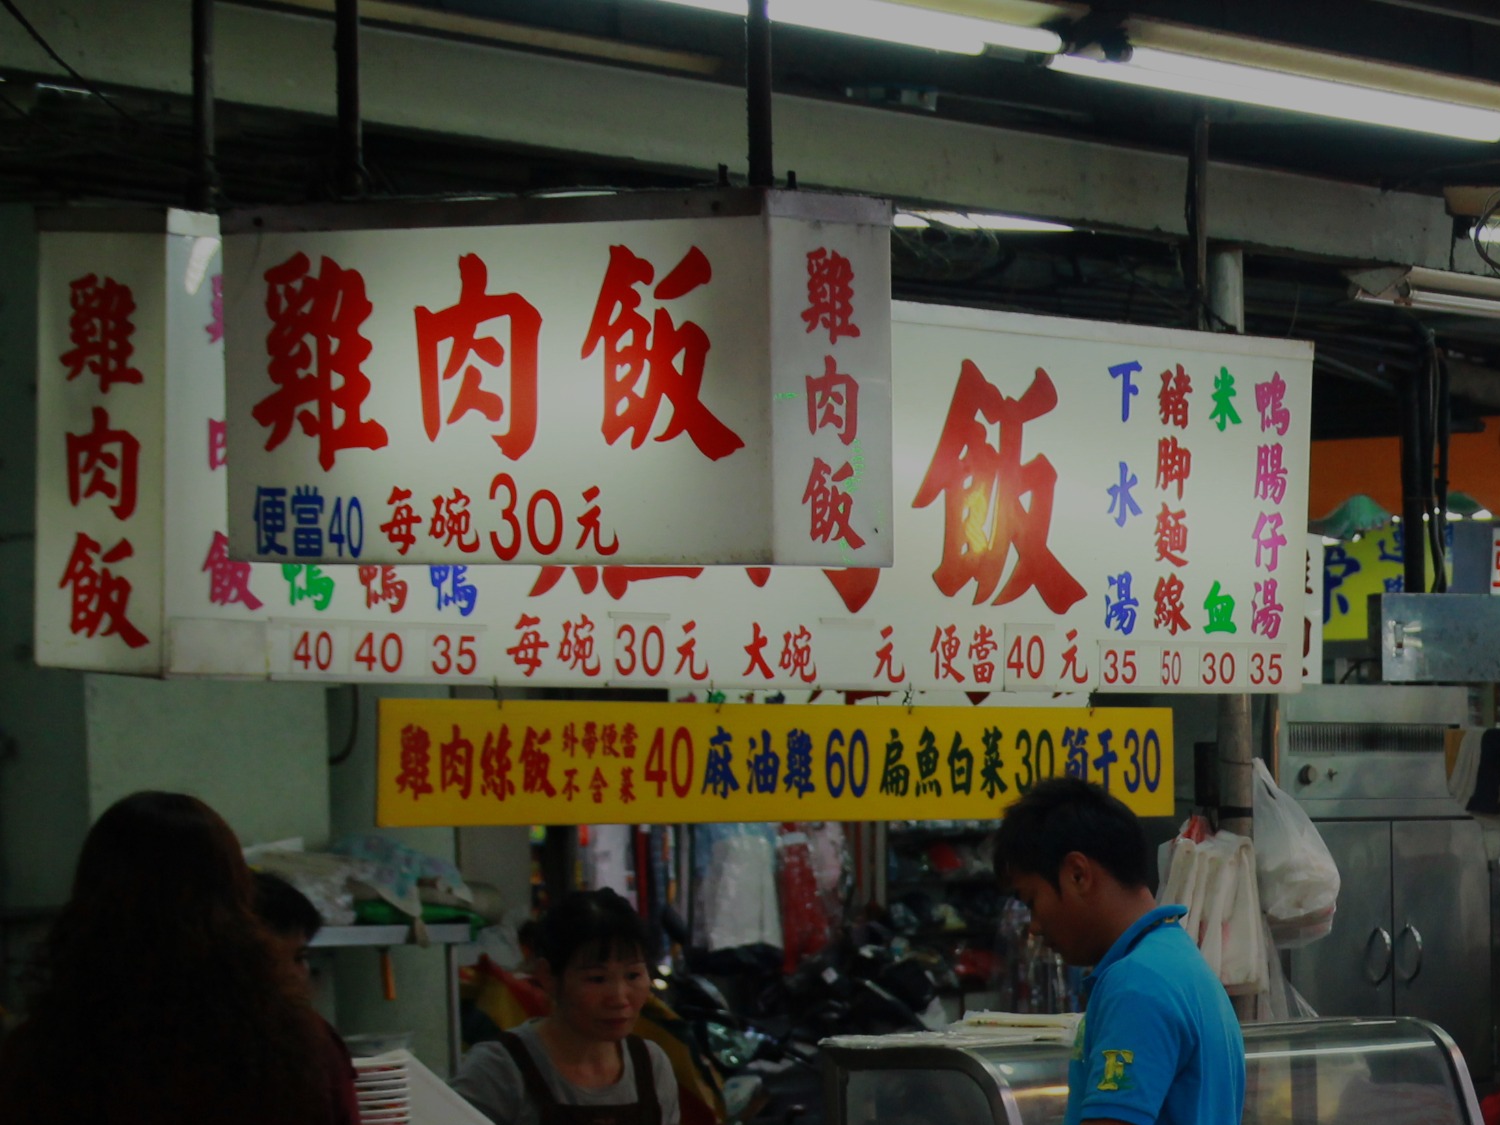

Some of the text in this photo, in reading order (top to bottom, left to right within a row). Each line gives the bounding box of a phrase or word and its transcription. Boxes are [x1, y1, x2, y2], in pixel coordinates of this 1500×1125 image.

[252, 246, 746, 472] 雞肉飯
[801, 246, 866, 550] 雞肉飯
[60, 273, 149, 648] 雞肉飯
[253, 473, 620, 562] 便當40 每碗30元
[1106, 361, 1142, 636] 下水湯
[1203, 366, 1242, 634] 米血
[1251, 371, 1290, 640] 鴨腸仔湯
[293, 630, 332, 671] 40
[355, 631, 402, 673] 40
[432, 634, 477, 675] 35
[506, 612, 709, 682] 每碗30元
[742, 620, 816, 684] 大碗
[930, 622, 1088, 685] 便當40元
[1104, 650, 1137, 684] 35
[1161, 651, 1181, 685] 50
[1203, 652, 1235, 685] 30
[1250, 653, 1283, 685] 35
[396, 723, 557, 801] 雞肉絲飯
[645, 727, 694, 798] 40
[701, 725, 815, 799] 麻油雞
[825, 729, 869, 798] 60
[879, 726, 1008, 799] 扁魚白菜
[1124, 728, 1161, 793] 30
